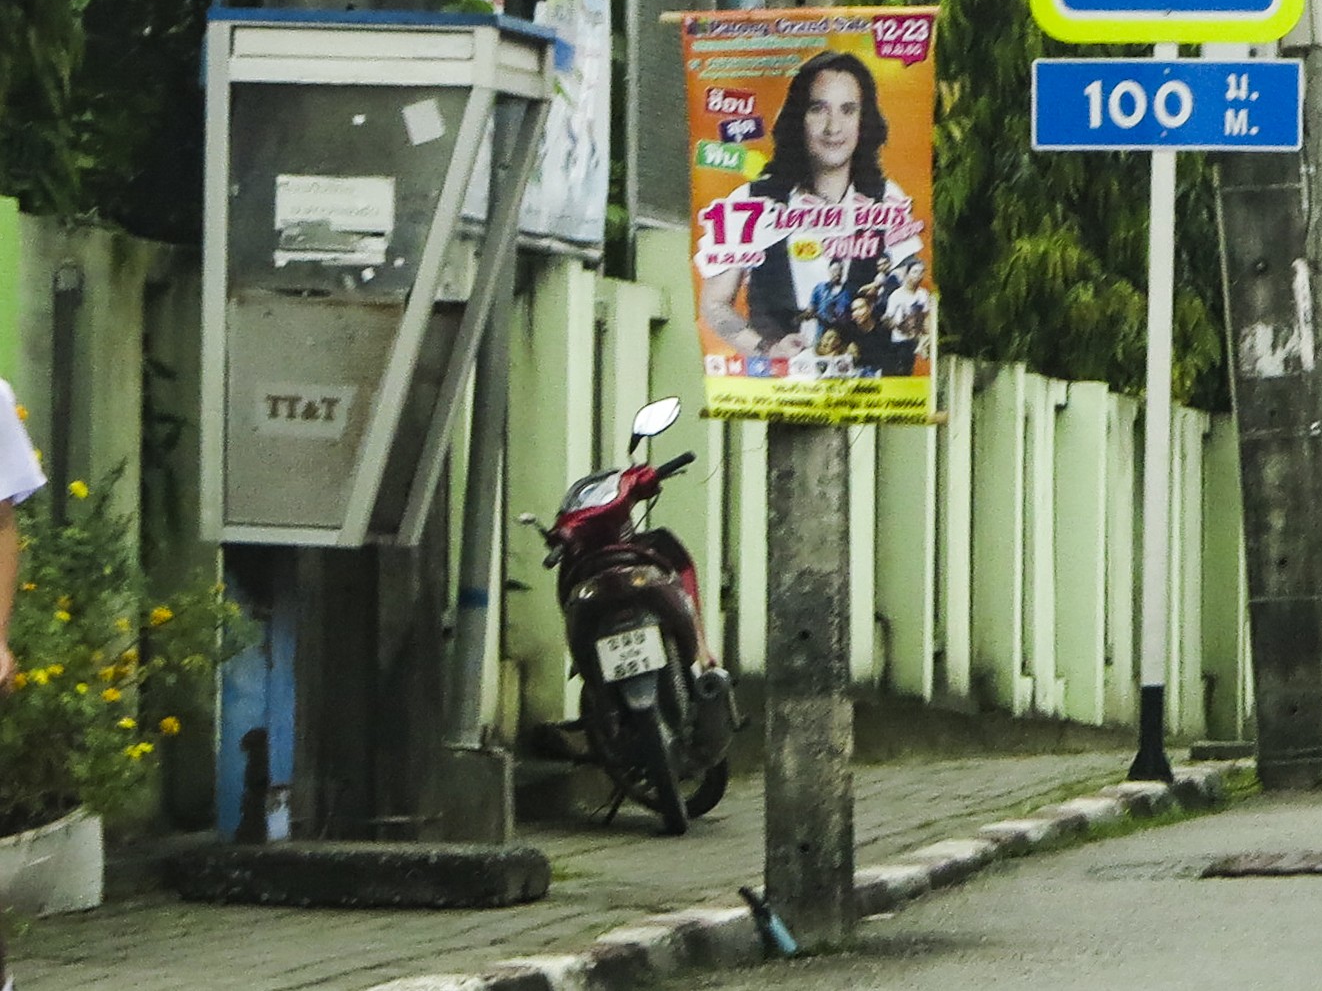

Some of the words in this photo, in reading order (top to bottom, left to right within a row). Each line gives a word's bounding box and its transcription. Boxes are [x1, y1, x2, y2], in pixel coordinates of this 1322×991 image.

[1083, 79, 1194, 129] 100
[1224, 72, 1260, 101] ม.
[703, 201, 766, 245] 17
[265, 394, 341, 421] TT&T
